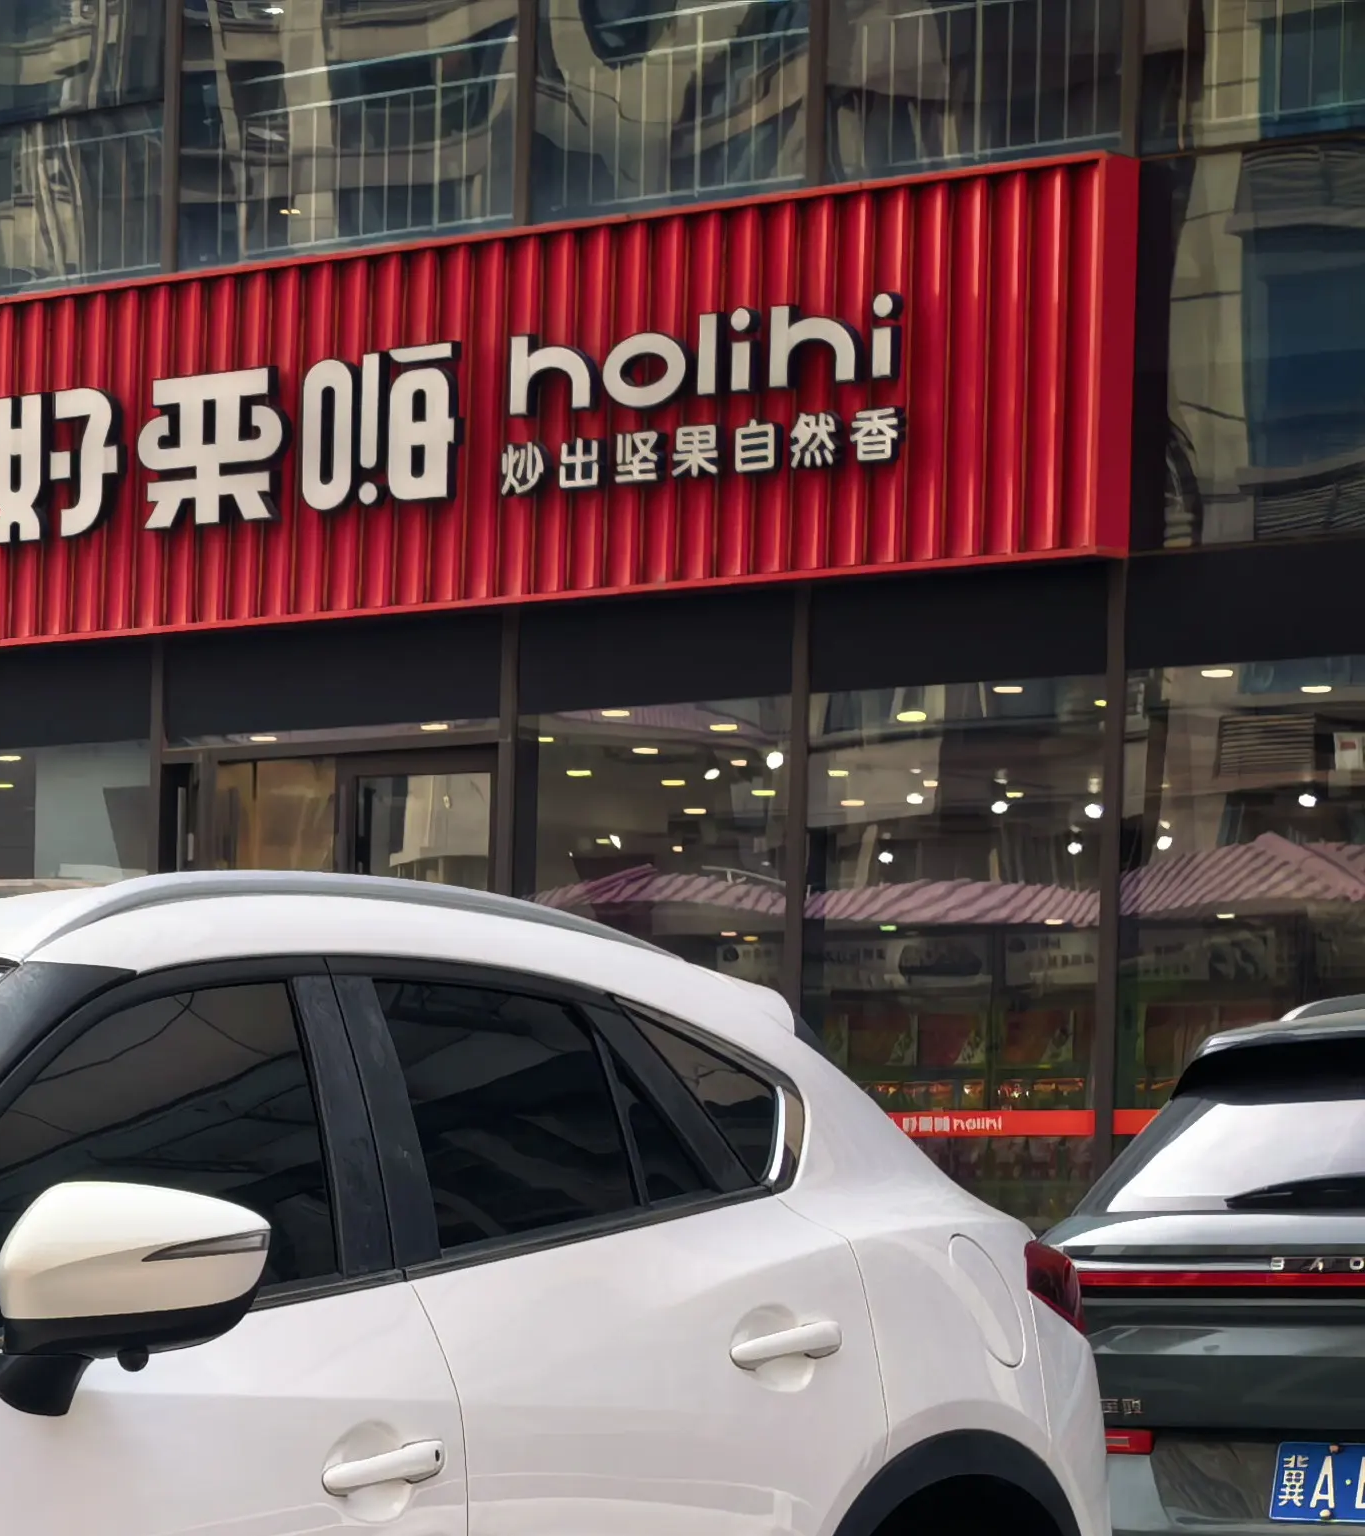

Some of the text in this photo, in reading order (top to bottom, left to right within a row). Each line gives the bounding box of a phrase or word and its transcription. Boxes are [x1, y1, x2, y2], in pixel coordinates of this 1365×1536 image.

[509, 292, 899, 416] holihi
[501, 407, 902, 495] 炒出坚果自然香
